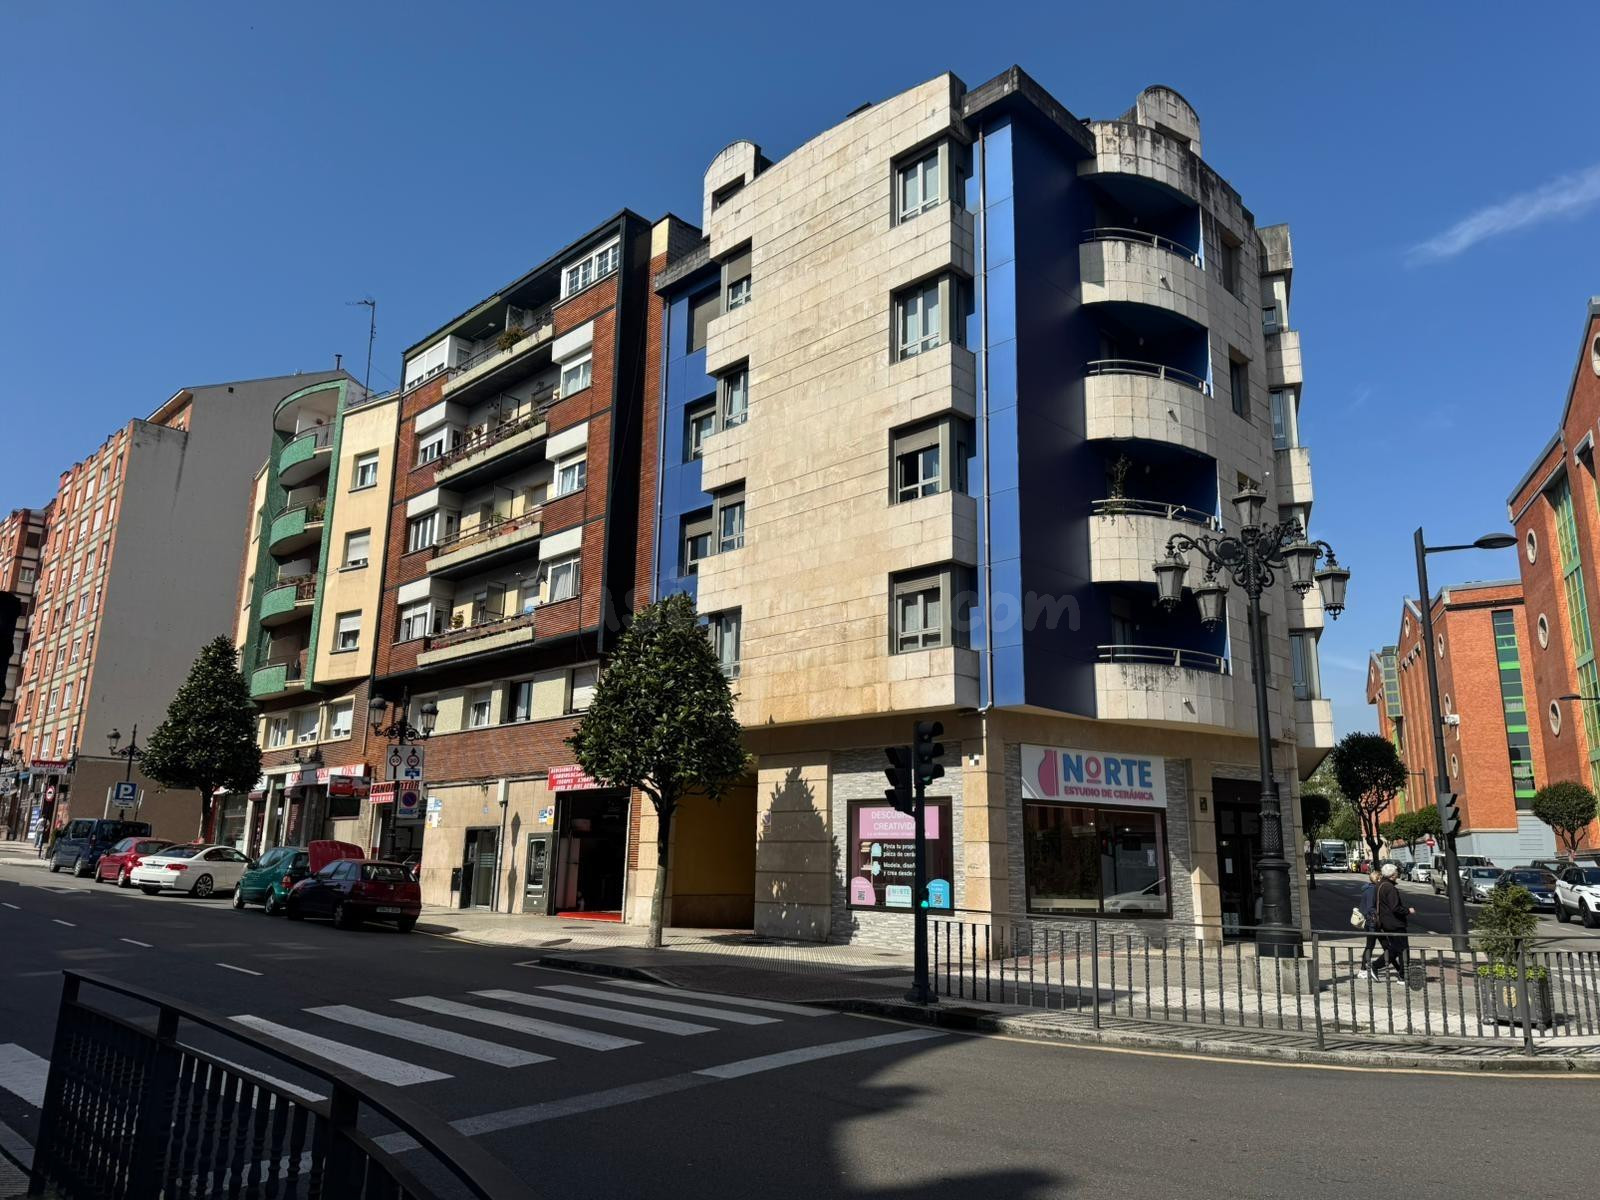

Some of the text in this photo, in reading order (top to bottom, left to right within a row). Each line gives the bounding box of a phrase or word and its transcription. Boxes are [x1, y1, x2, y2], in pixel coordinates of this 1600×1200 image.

[1062, 753, 1153, 788] NORTE
[119, 784, 133, 798] P
[1064, 786, 1154, 801] ESTUDIO DE CERÁMICA
